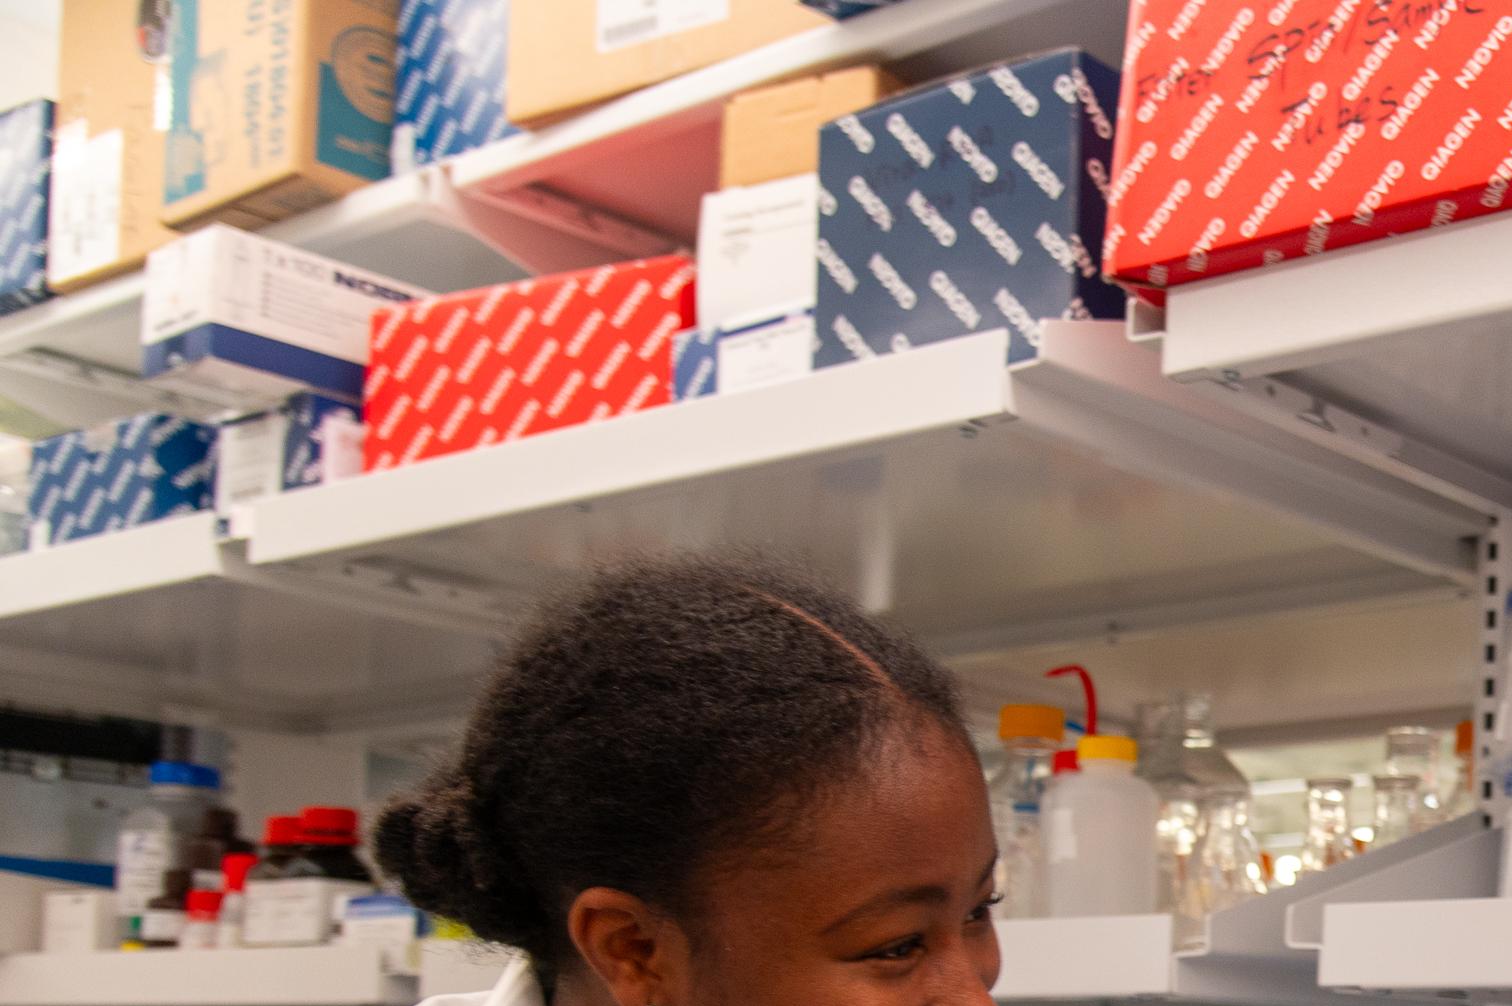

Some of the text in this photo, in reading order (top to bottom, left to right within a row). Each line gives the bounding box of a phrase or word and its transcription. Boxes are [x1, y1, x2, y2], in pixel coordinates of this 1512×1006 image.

[1200, 8, 1255, 76] QIAGEN
[1342, 29, 1400, 100] QIAGEN
[1170, 93, 1224, 161] QIAGEN
[1270, 81, 1328, 152] QIAGEN
[1381, 67, 1440, 140] QIAGEN
[1204, 130, 1259, 199] QIAGEN
[1308, 121, 1365, 191] QIAGEN
[1420, 107, 1482, 181] QIAGEN
[1137, 178, 1192, 246] QIAGEN
[1239, 169, 1296, 238] QIAGEN
[1351, 160, 1405, 227] QIAGEN
